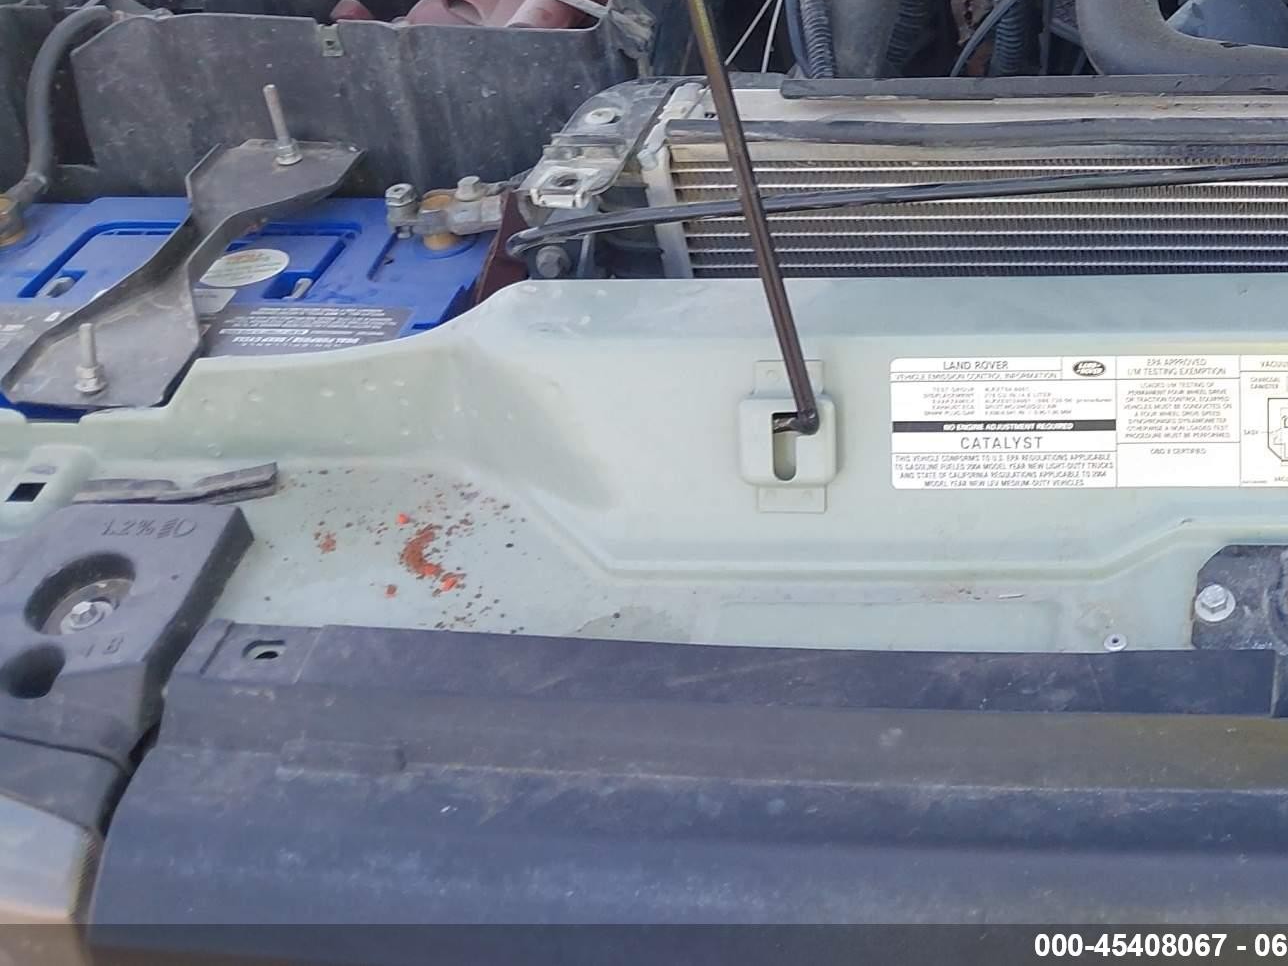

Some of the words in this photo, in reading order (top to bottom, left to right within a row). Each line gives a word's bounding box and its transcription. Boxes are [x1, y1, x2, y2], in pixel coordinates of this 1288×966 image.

[943, 361, 971, 370] LAND
[974, 360, 1008, 370] ROVER
[1179, 367, 1226, 375] EXEMPTION
[1036, 422, 1074, 430] REQUIRED
[960, 436, 1044, 450] CATALYST
